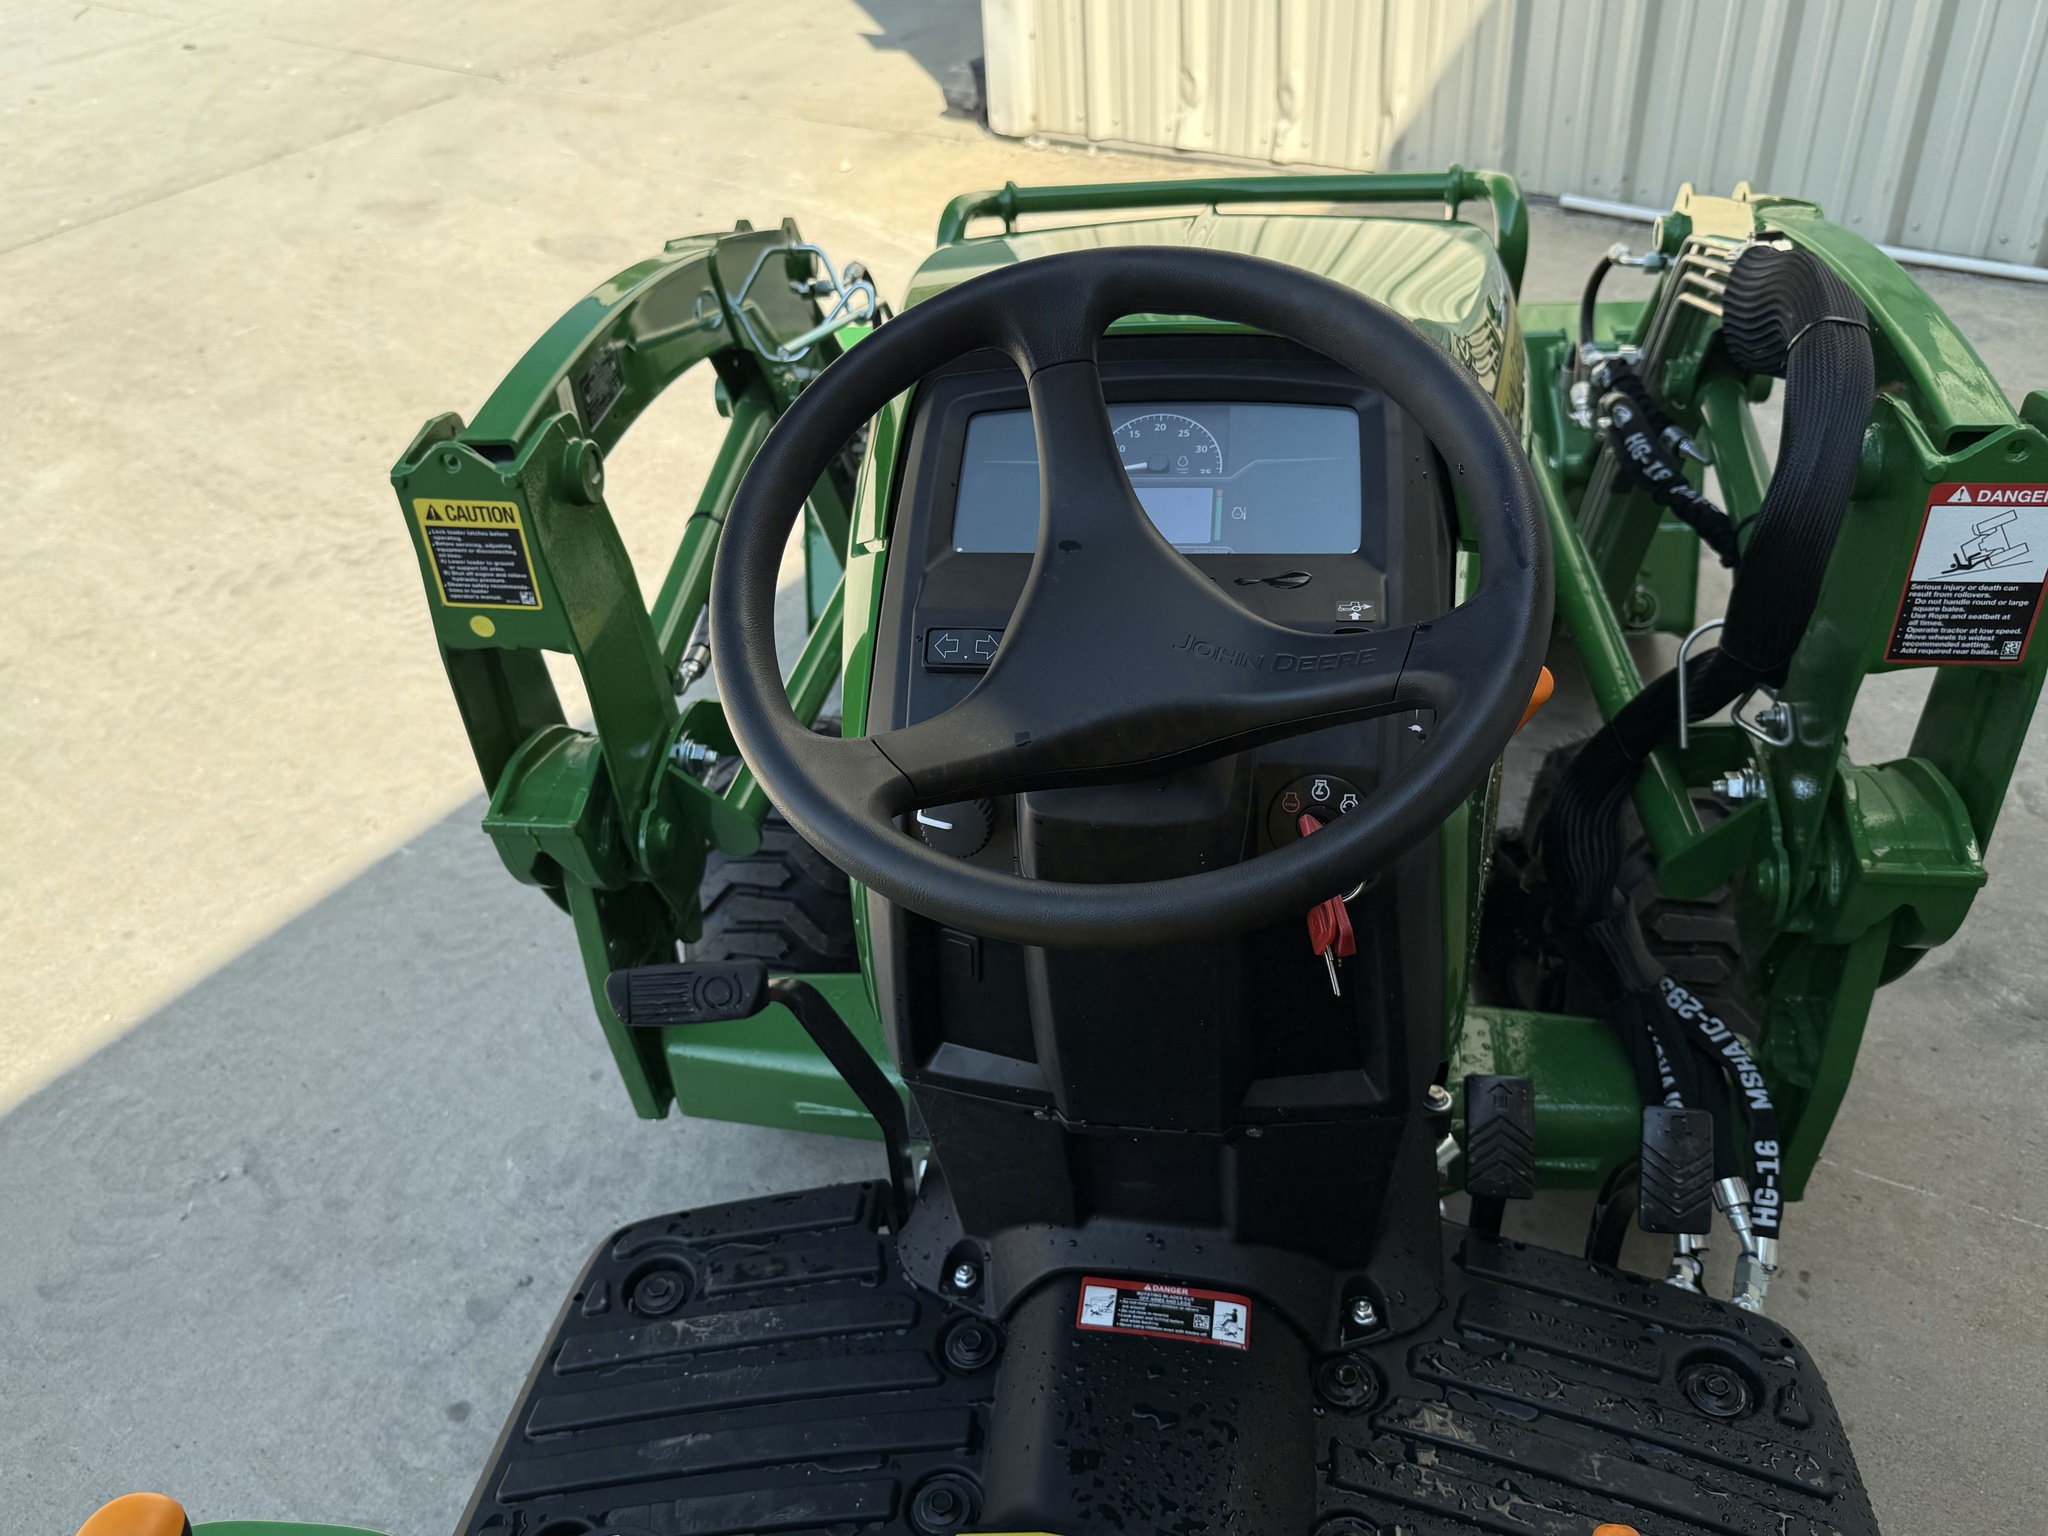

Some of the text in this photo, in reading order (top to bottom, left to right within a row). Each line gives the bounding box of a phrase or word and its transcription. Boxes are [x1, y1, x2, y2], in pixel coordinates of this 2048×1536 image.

[445, 505, 516, 523] CAUTION
[1172, 634, 1378, 672] JOHN DEERE
[1721, 1041, 1773, 1110] MSHA
[1752, 1139, 1780, 1228] HG-16
[1153, 1285, 1188, 1295] DANGER
